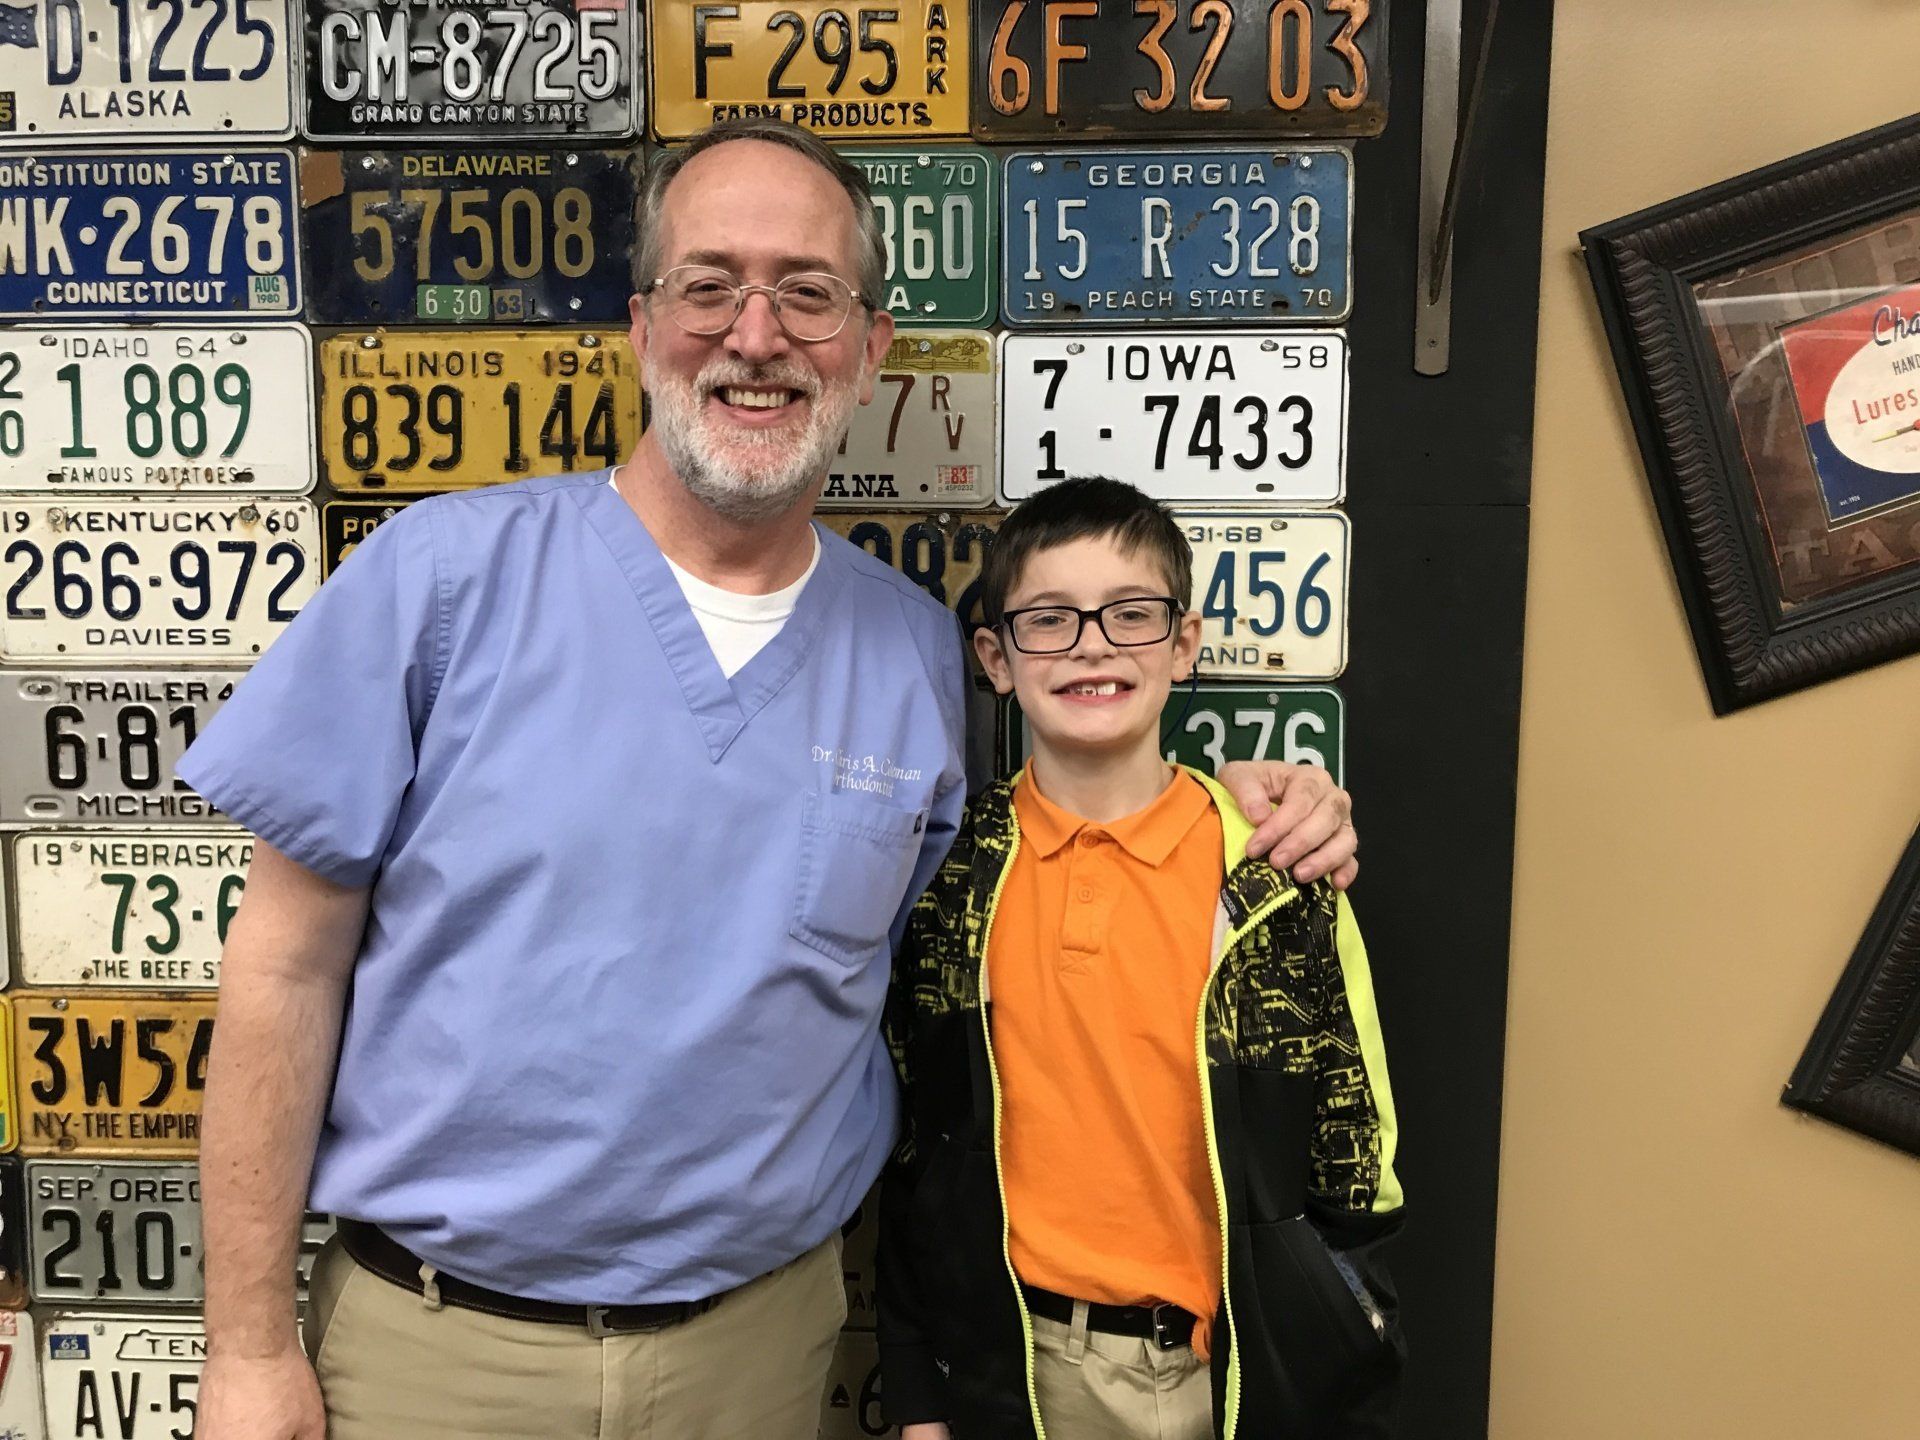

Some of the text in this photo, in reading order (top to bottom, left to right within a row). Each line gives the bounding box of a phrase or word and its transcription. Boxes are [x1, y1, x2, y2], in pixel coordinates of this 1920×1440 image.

[321, 10, 619, 101] CM-8725
[694, 4, 900, 99] F 295
[989, 0, 1098, 115] 6F
[58, 89, 192, 119] ALASKA
[429, 104, 515, 123] CANYON
[522, 103, 588, 122] STATE
[791, 102, 929, 127] PRODUCTS
[192, 161, 282, 185] STATE
[402, 155, 552, 177] DELAWARE
[858, 164, 976, 187] TATE 70
[1088, 163, 1266, 187] GEORGIA
[350, 188, 595, 281] 57508
[1023, 195, 1321, 280] 15 R 328
[47, 281, 227, 304] CONNECTICUT
[255, 276, 280, 292] AUG
[1023, 288, 1333, 309] 19 PEACH STATE 70
[63, 336, 218, 359] IDAHO 64
[339, 349, 620, 379] ILLINOIS 1941
[1106, 345, 1329, 381] IOWA 58
[56, 362, 251, 458] 1 889
[1852, 388, 1919, 425] Lures
[341, 381, 621, 473] 839 144
[1143, 395, 1314, 471] 7433
[60, 466, 238, 483] FAMOUS POTATOES
[821, 474, 899, 498] ANA
[2, 511, 300, 534] 19 KENTUCKY 60
[1202, 551, 1332, 638] 456
[85, 628, 232, 646] DAVIESS
[64, 681, 209, 701] TRAILER
[811, 745, 834, 762] Dr.
[32, 843, 254, 868] 19 NEBRASKA
[92, 960, 130, 979] THE
[141, 960, 191, 979] BEEF
[129, 1112, 202, 1139] EMPIR
[61, 1339, 79, 1350] 65
